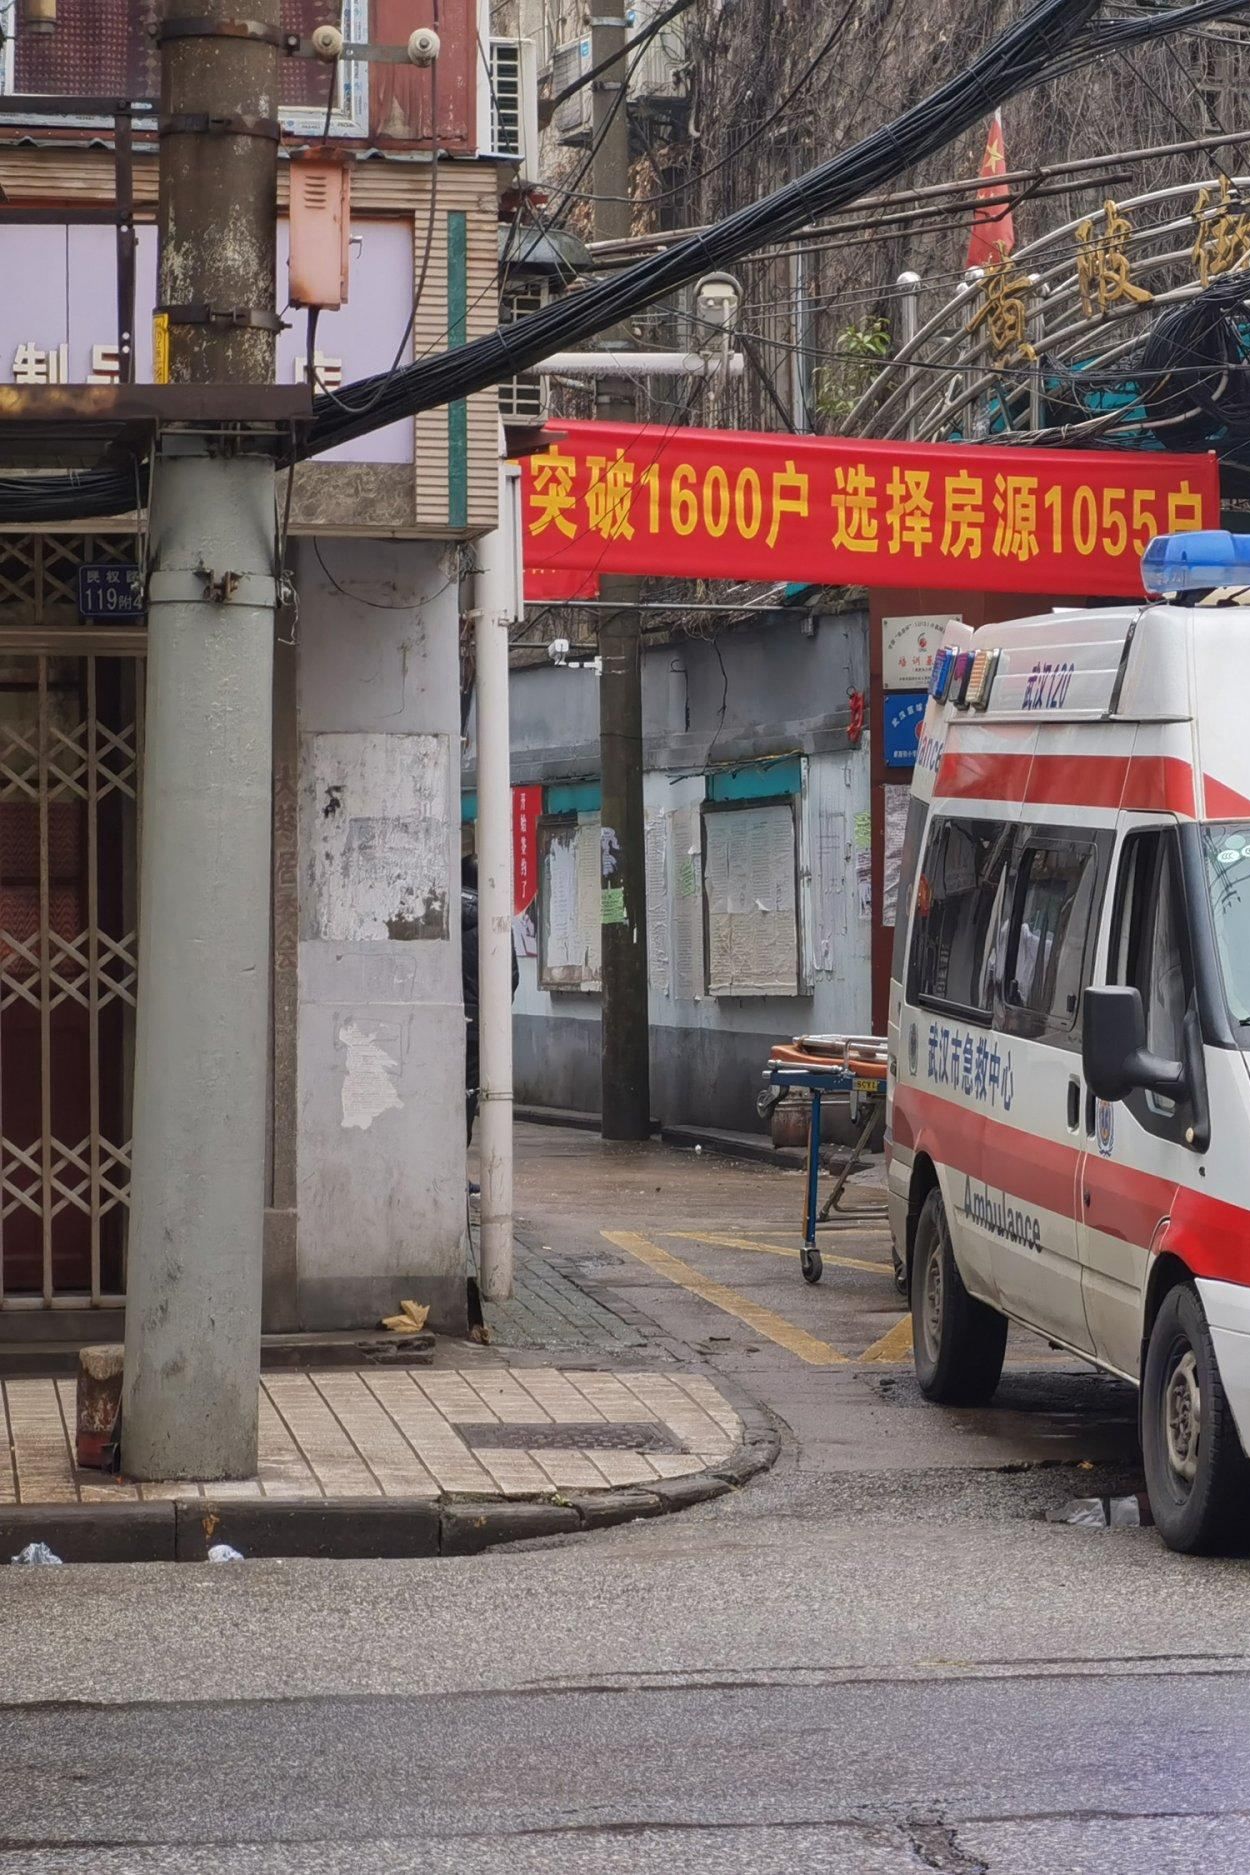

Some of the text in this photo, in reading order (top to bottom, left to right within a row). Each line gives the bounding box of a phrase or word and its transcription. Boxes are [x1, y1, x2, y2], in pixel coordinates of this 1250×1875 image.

[529, 445, 809, 549] 突破1600户
[927, 1020, 1015, 1111] 武汉市急救中心
[963, 1176, 1043, 1252] Ambulance
